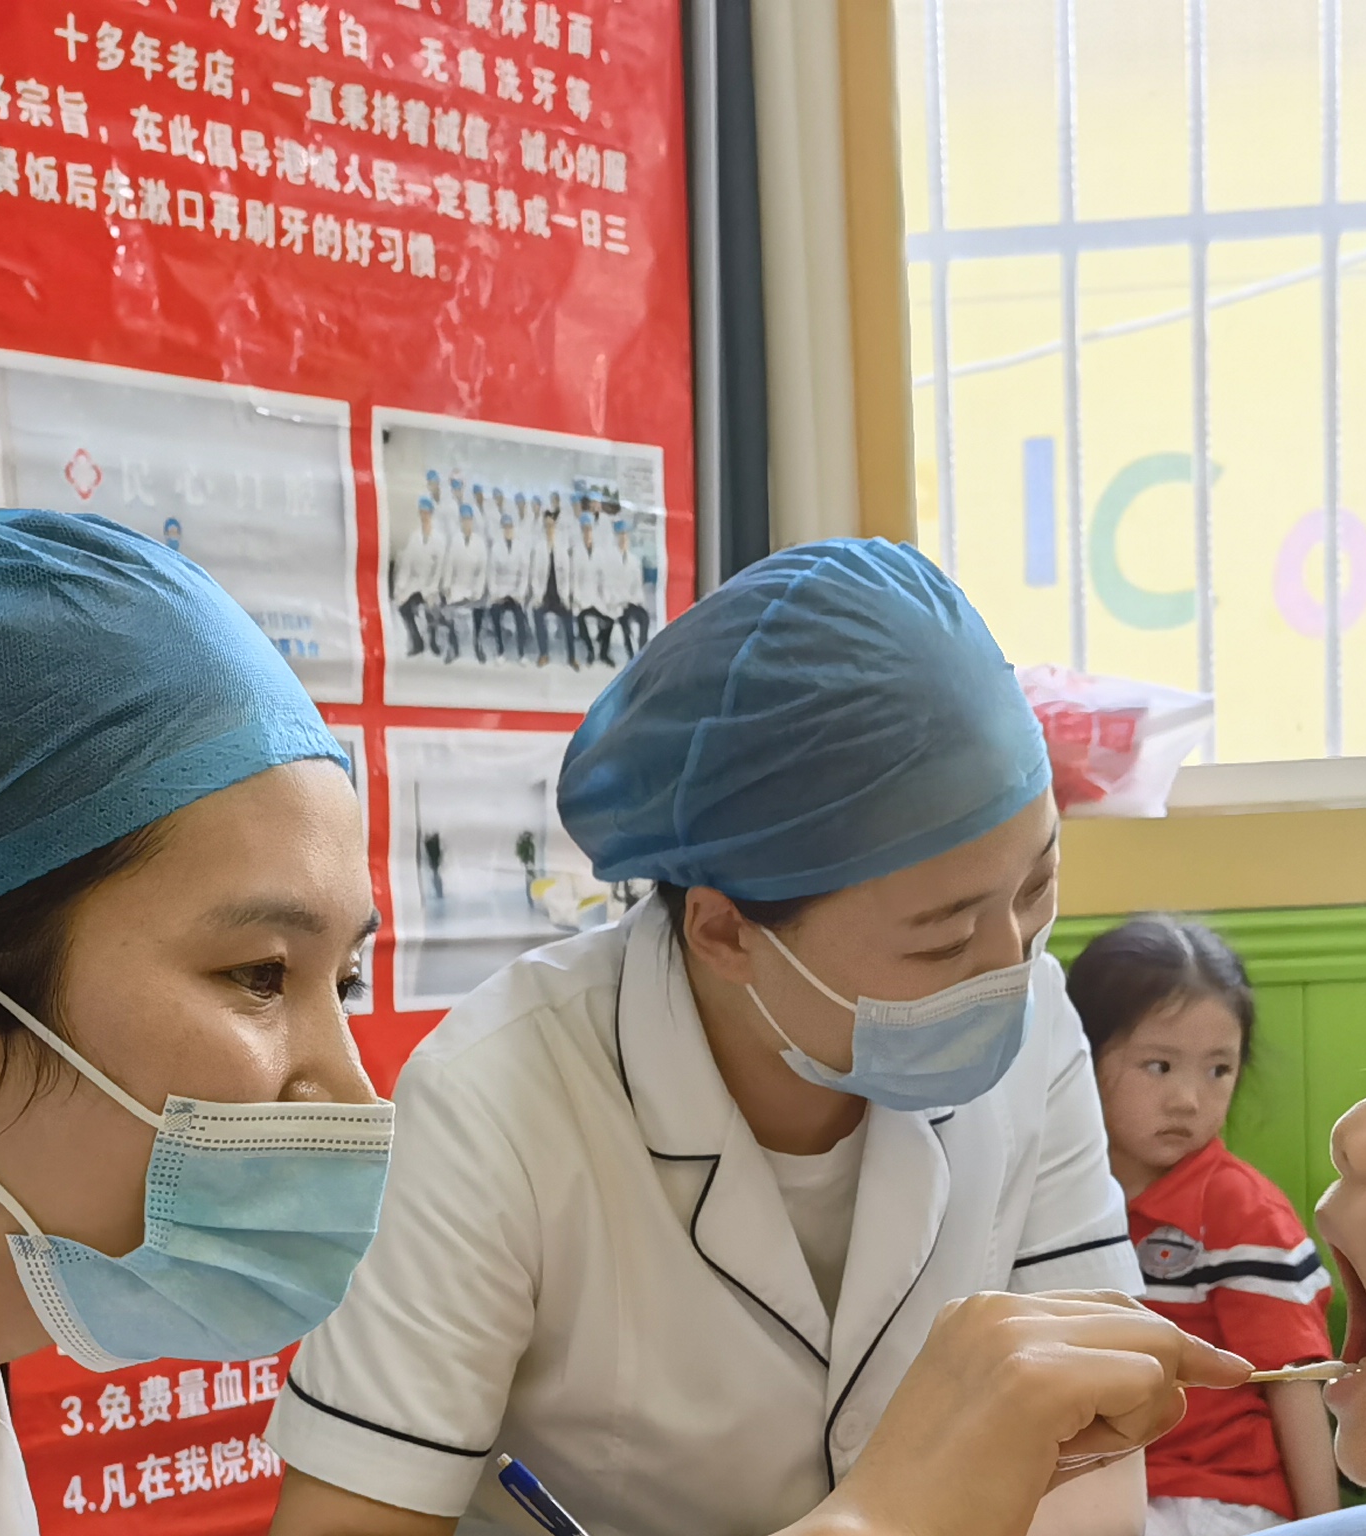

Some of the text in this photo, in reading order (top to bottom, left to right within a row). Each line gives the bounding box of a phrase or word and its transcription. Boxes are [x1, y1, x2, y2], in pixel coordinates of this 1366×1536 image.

[60, 1355, 281, 1437] 3.免费量血压
